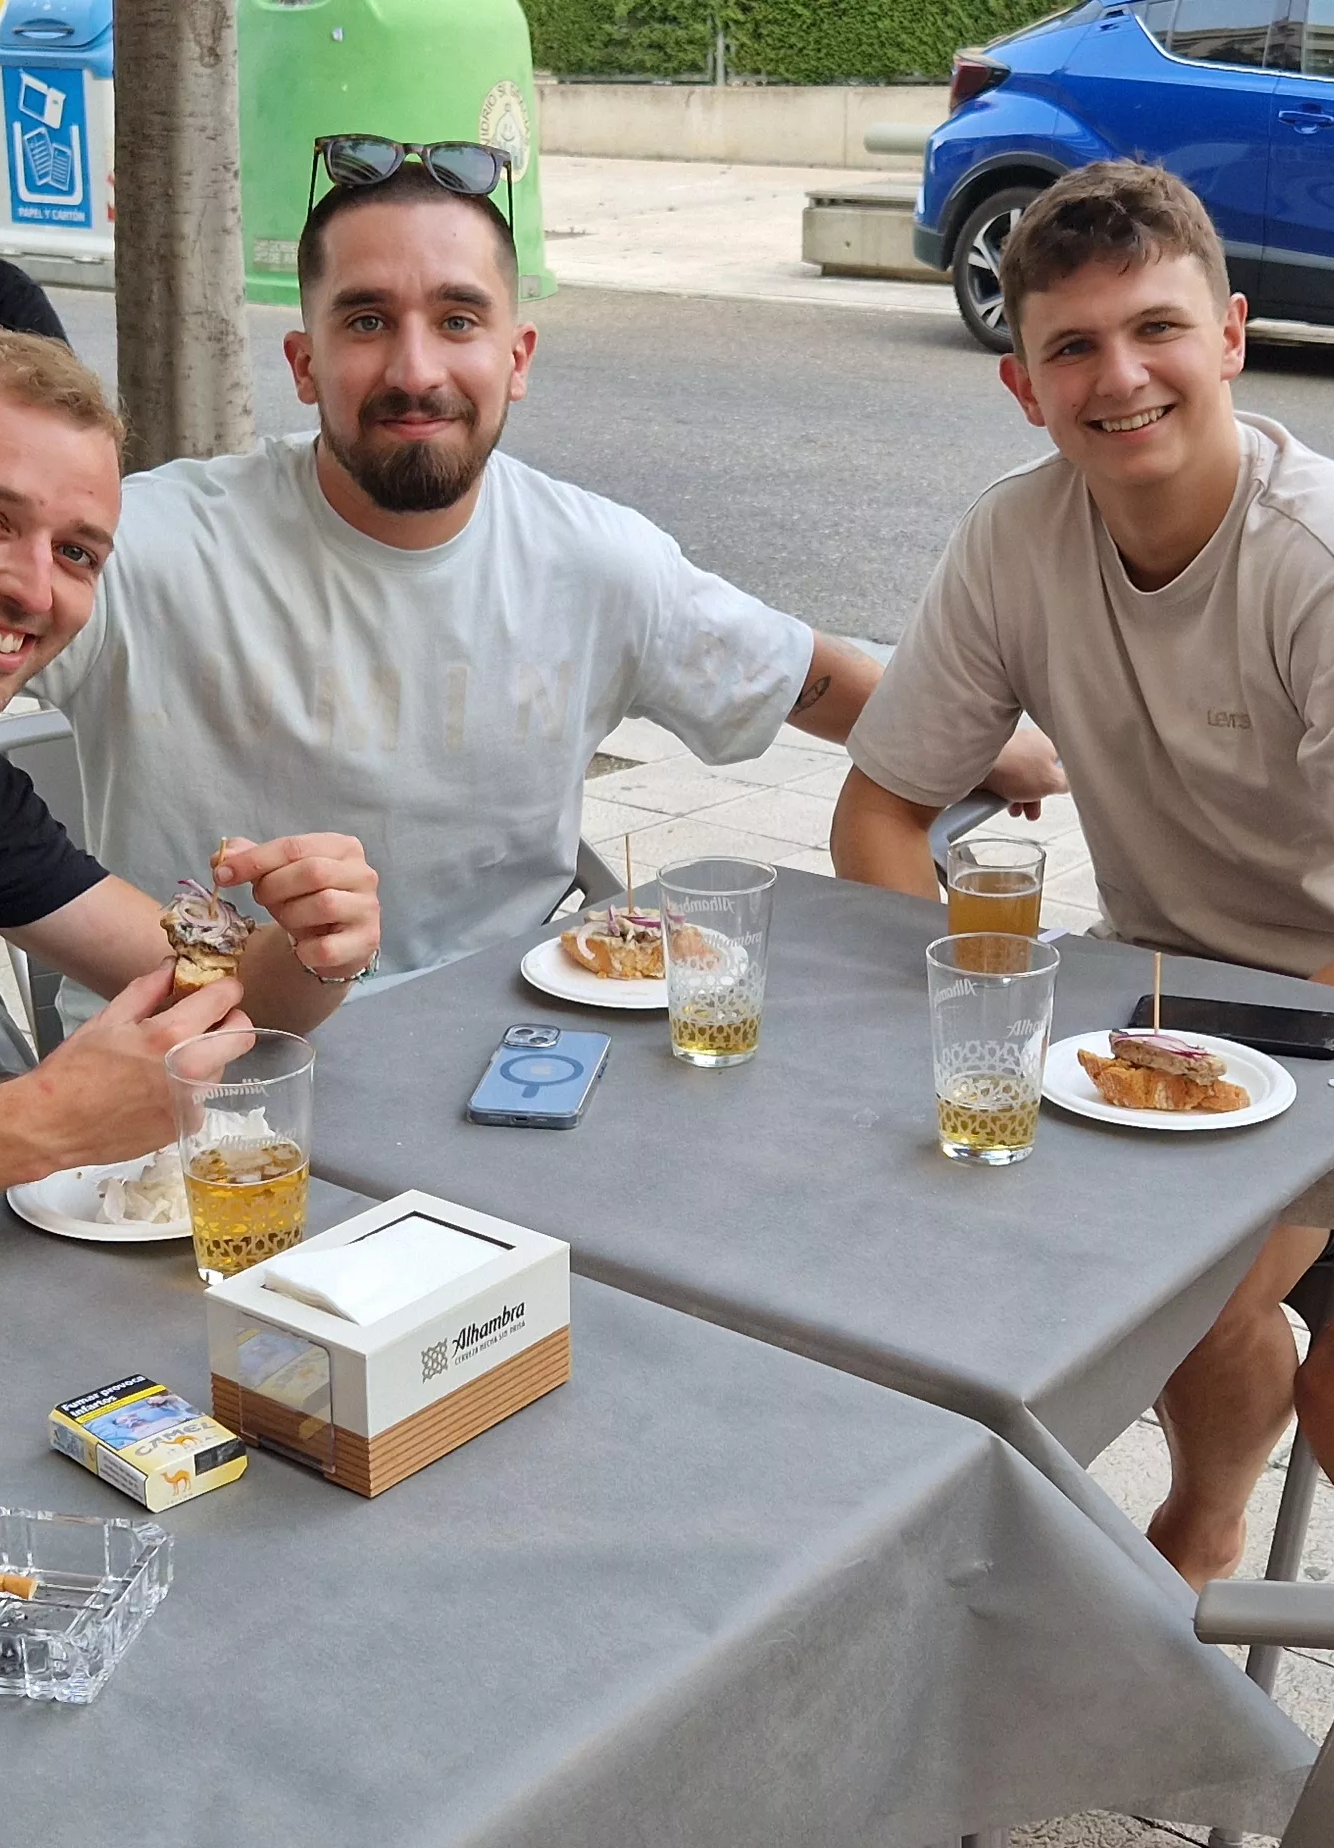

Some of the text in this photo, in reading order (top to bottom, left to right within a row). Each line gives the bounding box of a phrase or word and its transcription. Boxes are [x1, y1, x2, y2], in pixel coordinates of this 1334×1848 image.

[450, 1301, 526, 1360] Alhambra
[60, 1392, 100, 1412] Fumar
[100, 1375, 146, 1397] provoca
[134, 1422, 217, 1457] CAMEL
